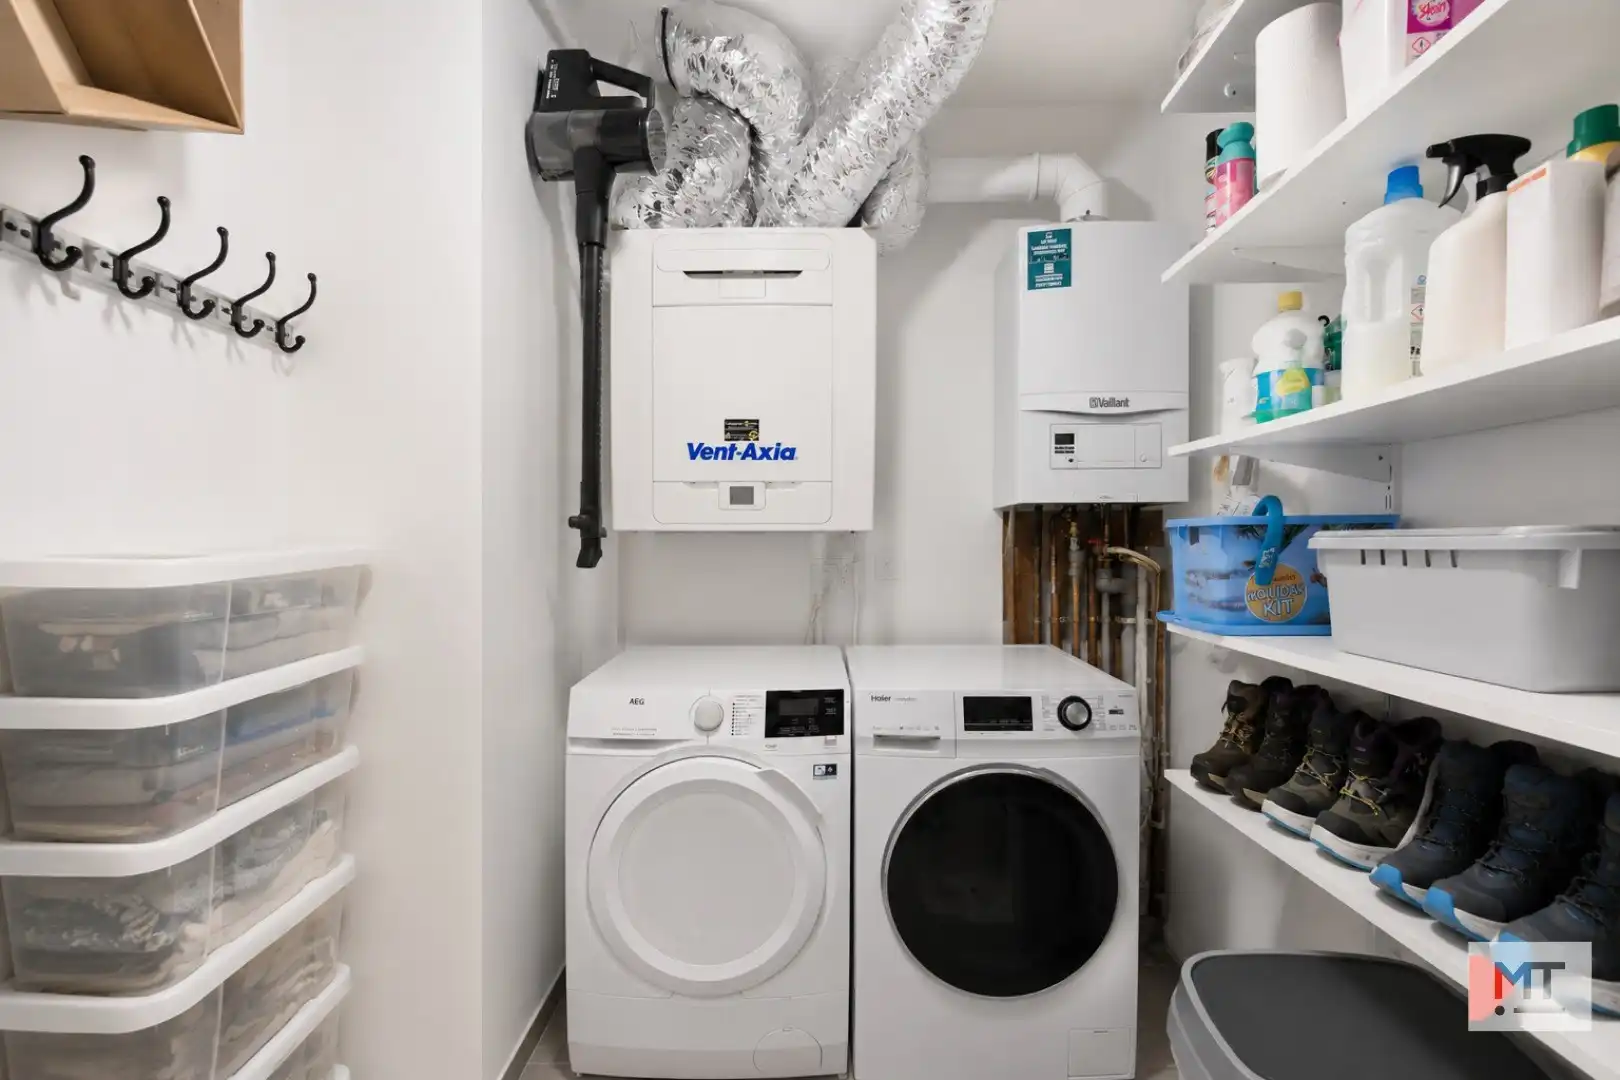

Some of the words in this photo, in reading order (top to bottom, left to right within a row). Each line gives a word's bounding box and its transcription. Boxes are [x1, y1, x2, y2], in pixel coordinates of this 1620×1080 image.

[1100, 397, 1130, 408] Vaillant
[687, 442, 797, 460] Vent-Axia
[1263, 599, 1293, 617] KIT
[629, 698, 645, 706] AEG
